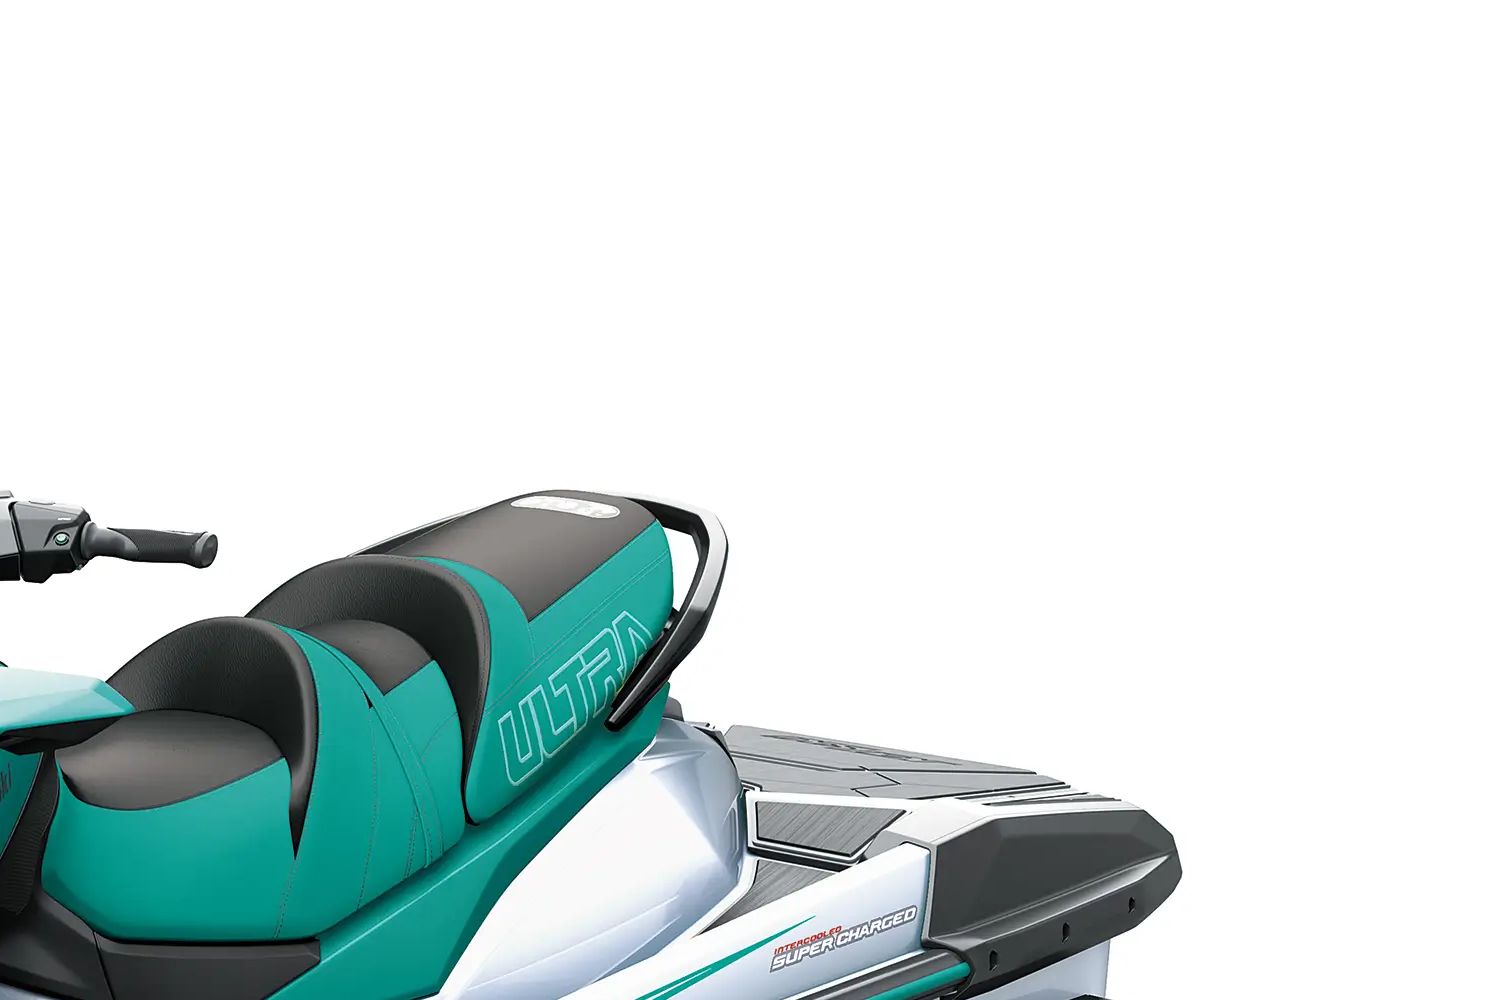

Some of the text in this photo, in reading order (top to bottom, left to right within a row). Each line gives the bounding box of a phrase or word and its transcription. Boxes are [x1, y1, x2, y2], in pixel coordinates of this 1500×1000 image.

[497, 610, 653, 787] ULTRA
[770, 905, 918, 973] SUPER CHARGED
[773, 925, 842, 955] INTERCOOLED
